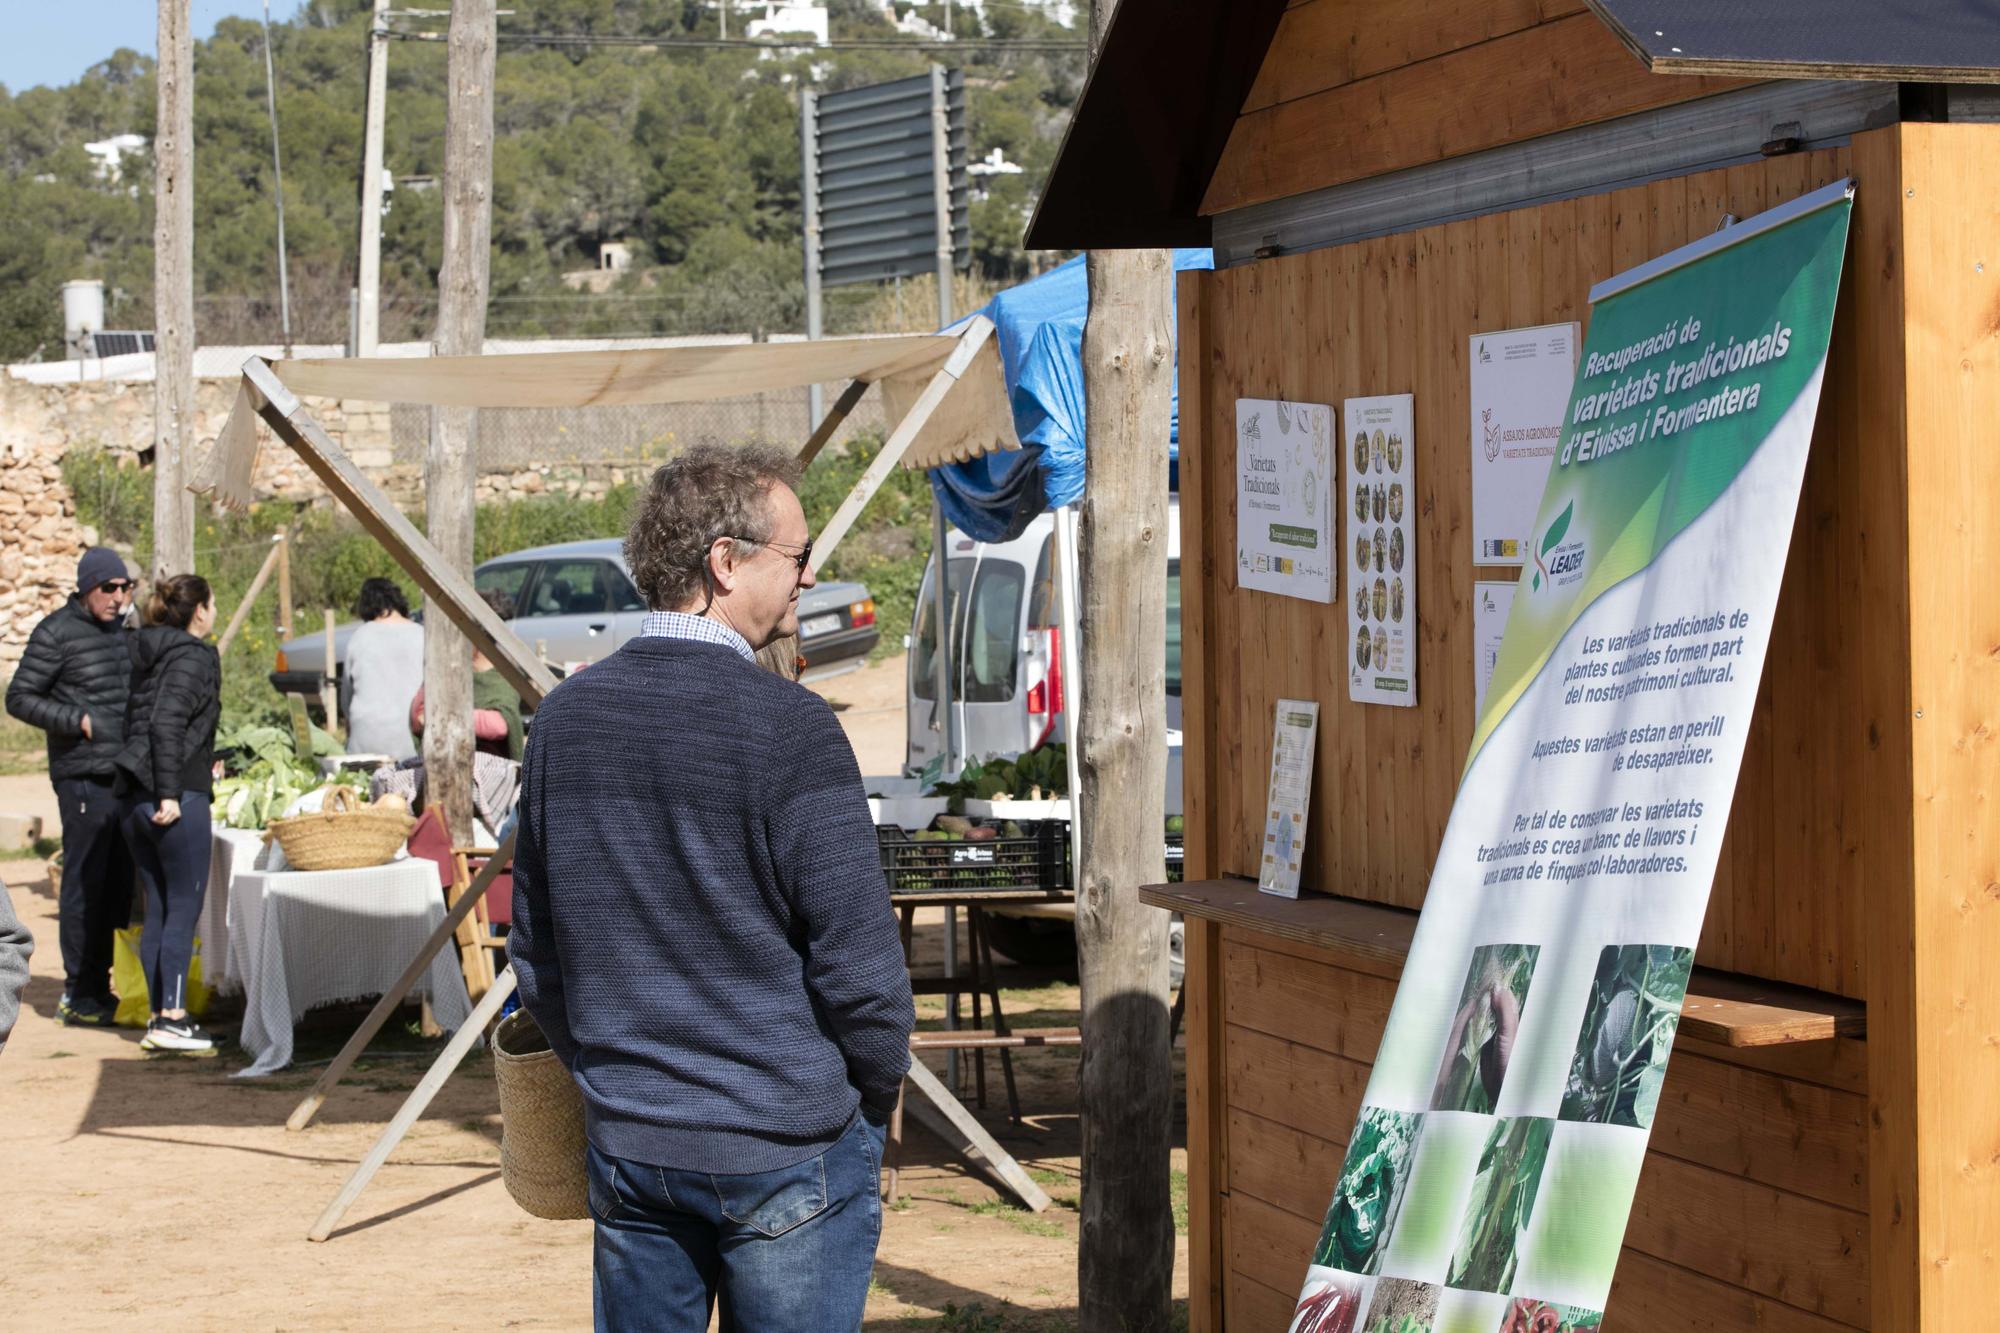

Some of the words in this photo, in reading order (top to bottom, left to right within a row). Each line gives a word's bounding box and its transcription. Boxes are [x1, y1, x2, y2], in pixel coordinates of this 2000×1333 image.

[1584, 320, 1677, 379] Recuperació
[1679, 315, 1701, 345] de
[1572, 369, 1660, 425] varietats
[1664, 321, 1792, 394] tradicionals
[1639, 408, 1651, 442] i
[1650, 383, 1761, 439] Formentera
[1249, 454, 1276, 472] Varietats
[1243, 475, 1280, 495] Tradicionals
[1550, 550, 1585, 575] LEADER
[1582, 636, 1604, 655] Les
[1608, 626, 1651, 652] varietats
[1653, 610, 1725, 641] tradicionals
[1729, 608, 1749, 629] de
[1563, 662, 1608, 687] plantes
[1611, 648, 1661, 677] cultivades
[1664, 640, 1708, 665] formen
[1710, 636, 1744, 662] part
[1564, 684, 1584, 705] del
[1586, 681, 1625, 703] nostre
[1624, 668, 1680, 703] patrimoni
[1680, 662, 1734, 687] cultural.
[1531, 736, 1581, 762] Aquestes
[1585, 728, 1628, 753] varietats
[1629, 724, 1666, 744] estan
[1668, 723, 1684, 741] en
[1684, 715, 1726, 743] perill
[1612, 752, 1624, 772] de
[1626, 743, 1714, 773] desaparèixer.
[1513, 814, 1530, 833] Per
[1531, 810, 1548, 830] tal
[1549, 809, 1567, 830] de
[1570, 805, 1619, 829] conservar
[1621, 801, 1642, 822] les
[1645, 798, 1704, 821] varietats
[1477, 836, 1530, 863] tradicionals
[1532, 839, 1548, 855] es
[1551, 838, 1581, 855] crea
[1582, 837, 1593, 853] un
[1592, 830, 1620, 851] banc
[1623, 827, 1641, 848] de
[1643, 827, 1686, 847] llavors
[1690, 824, 1698, 846] i
[1483, 869, 1499, 886] una
[1498, 863, 1524, 883] xarxa
[1526, 860, 1543, 880] de
[1547, 860, 1587, 885] finques
